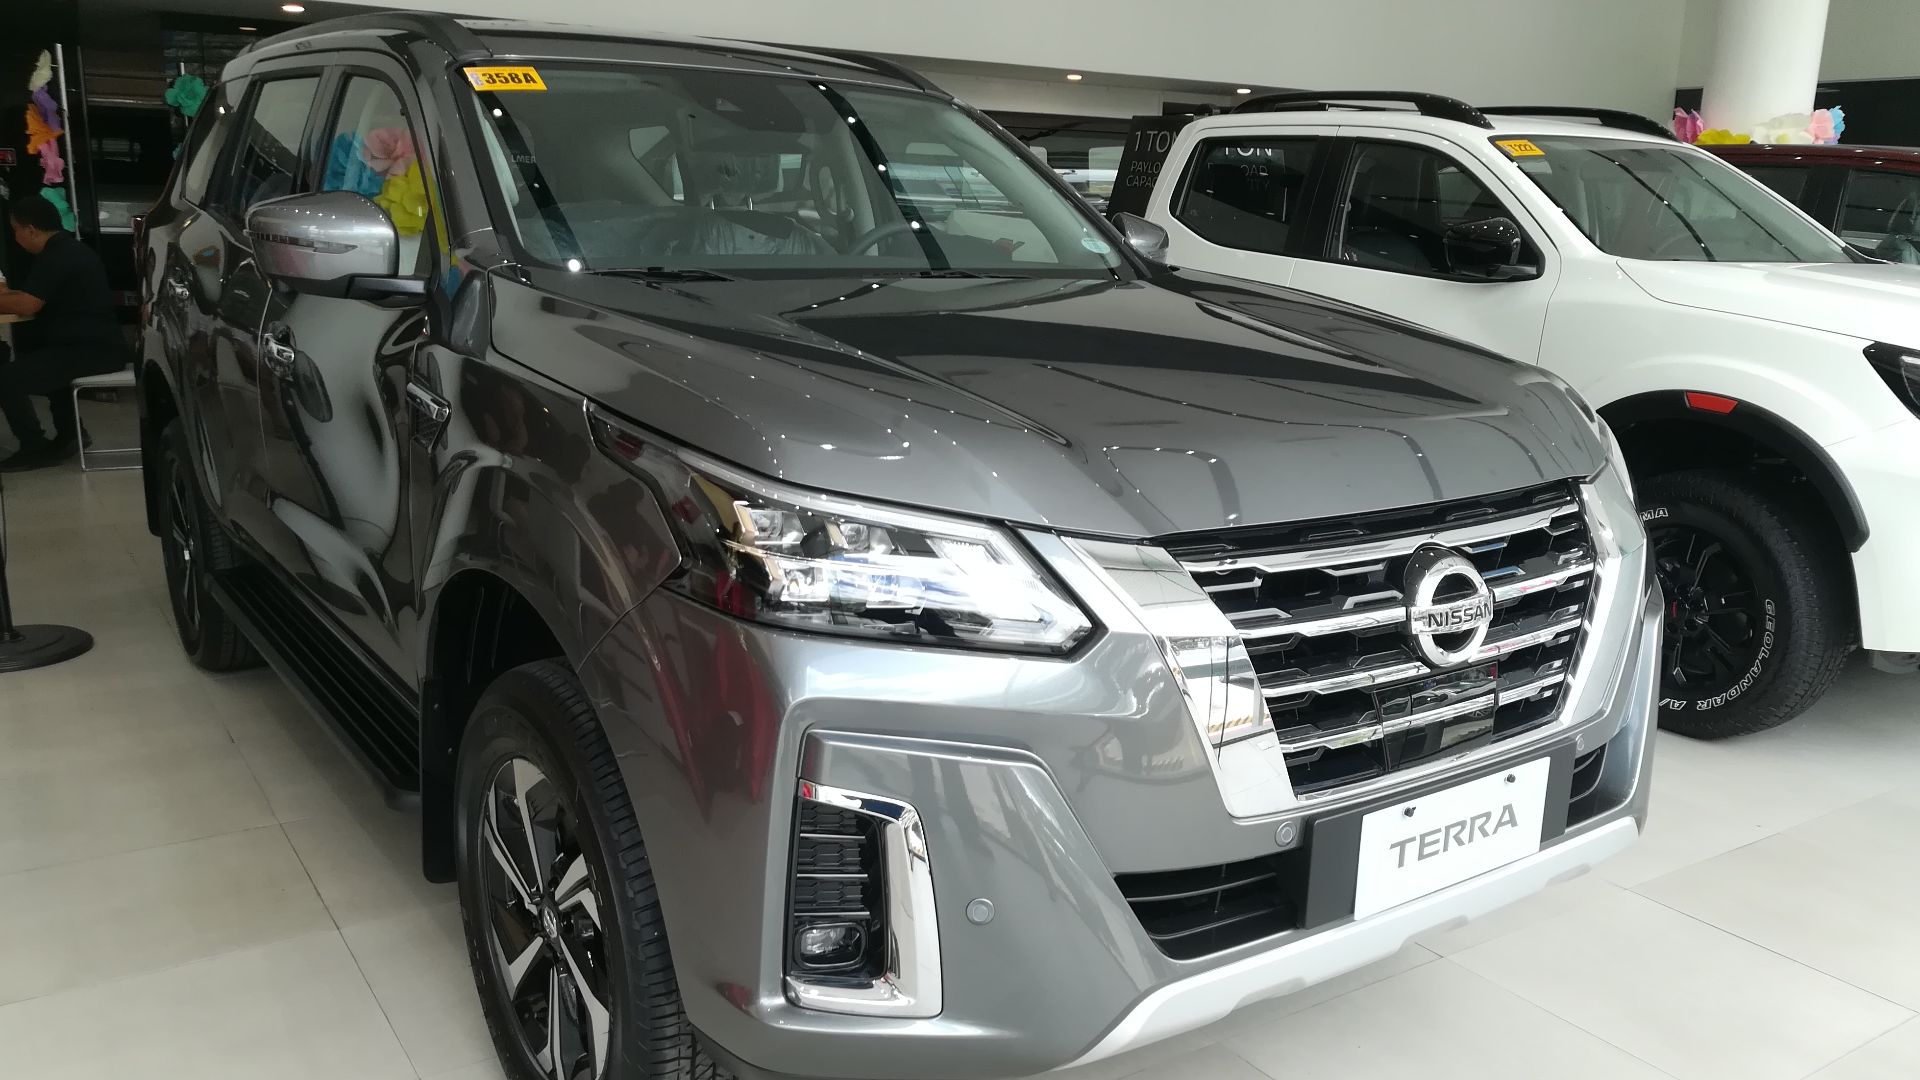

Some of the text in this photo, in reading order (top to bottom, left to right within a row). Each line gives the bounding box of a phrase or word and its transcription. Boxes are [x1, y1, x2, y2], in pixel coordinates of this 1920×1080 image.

[482, 72, 537, 84] 358A
[1131, 160, 1161, 174] PAYLO
[1126, 175, 1157, 188] CAPAC
[1640, 507, 1669, 521] MA
[1427, 602, 1492, 628] NISSAN
[1659, 598, 1776, 711] GEOLANDAR A/
[1389, 803, 1519, 869] TERRA
